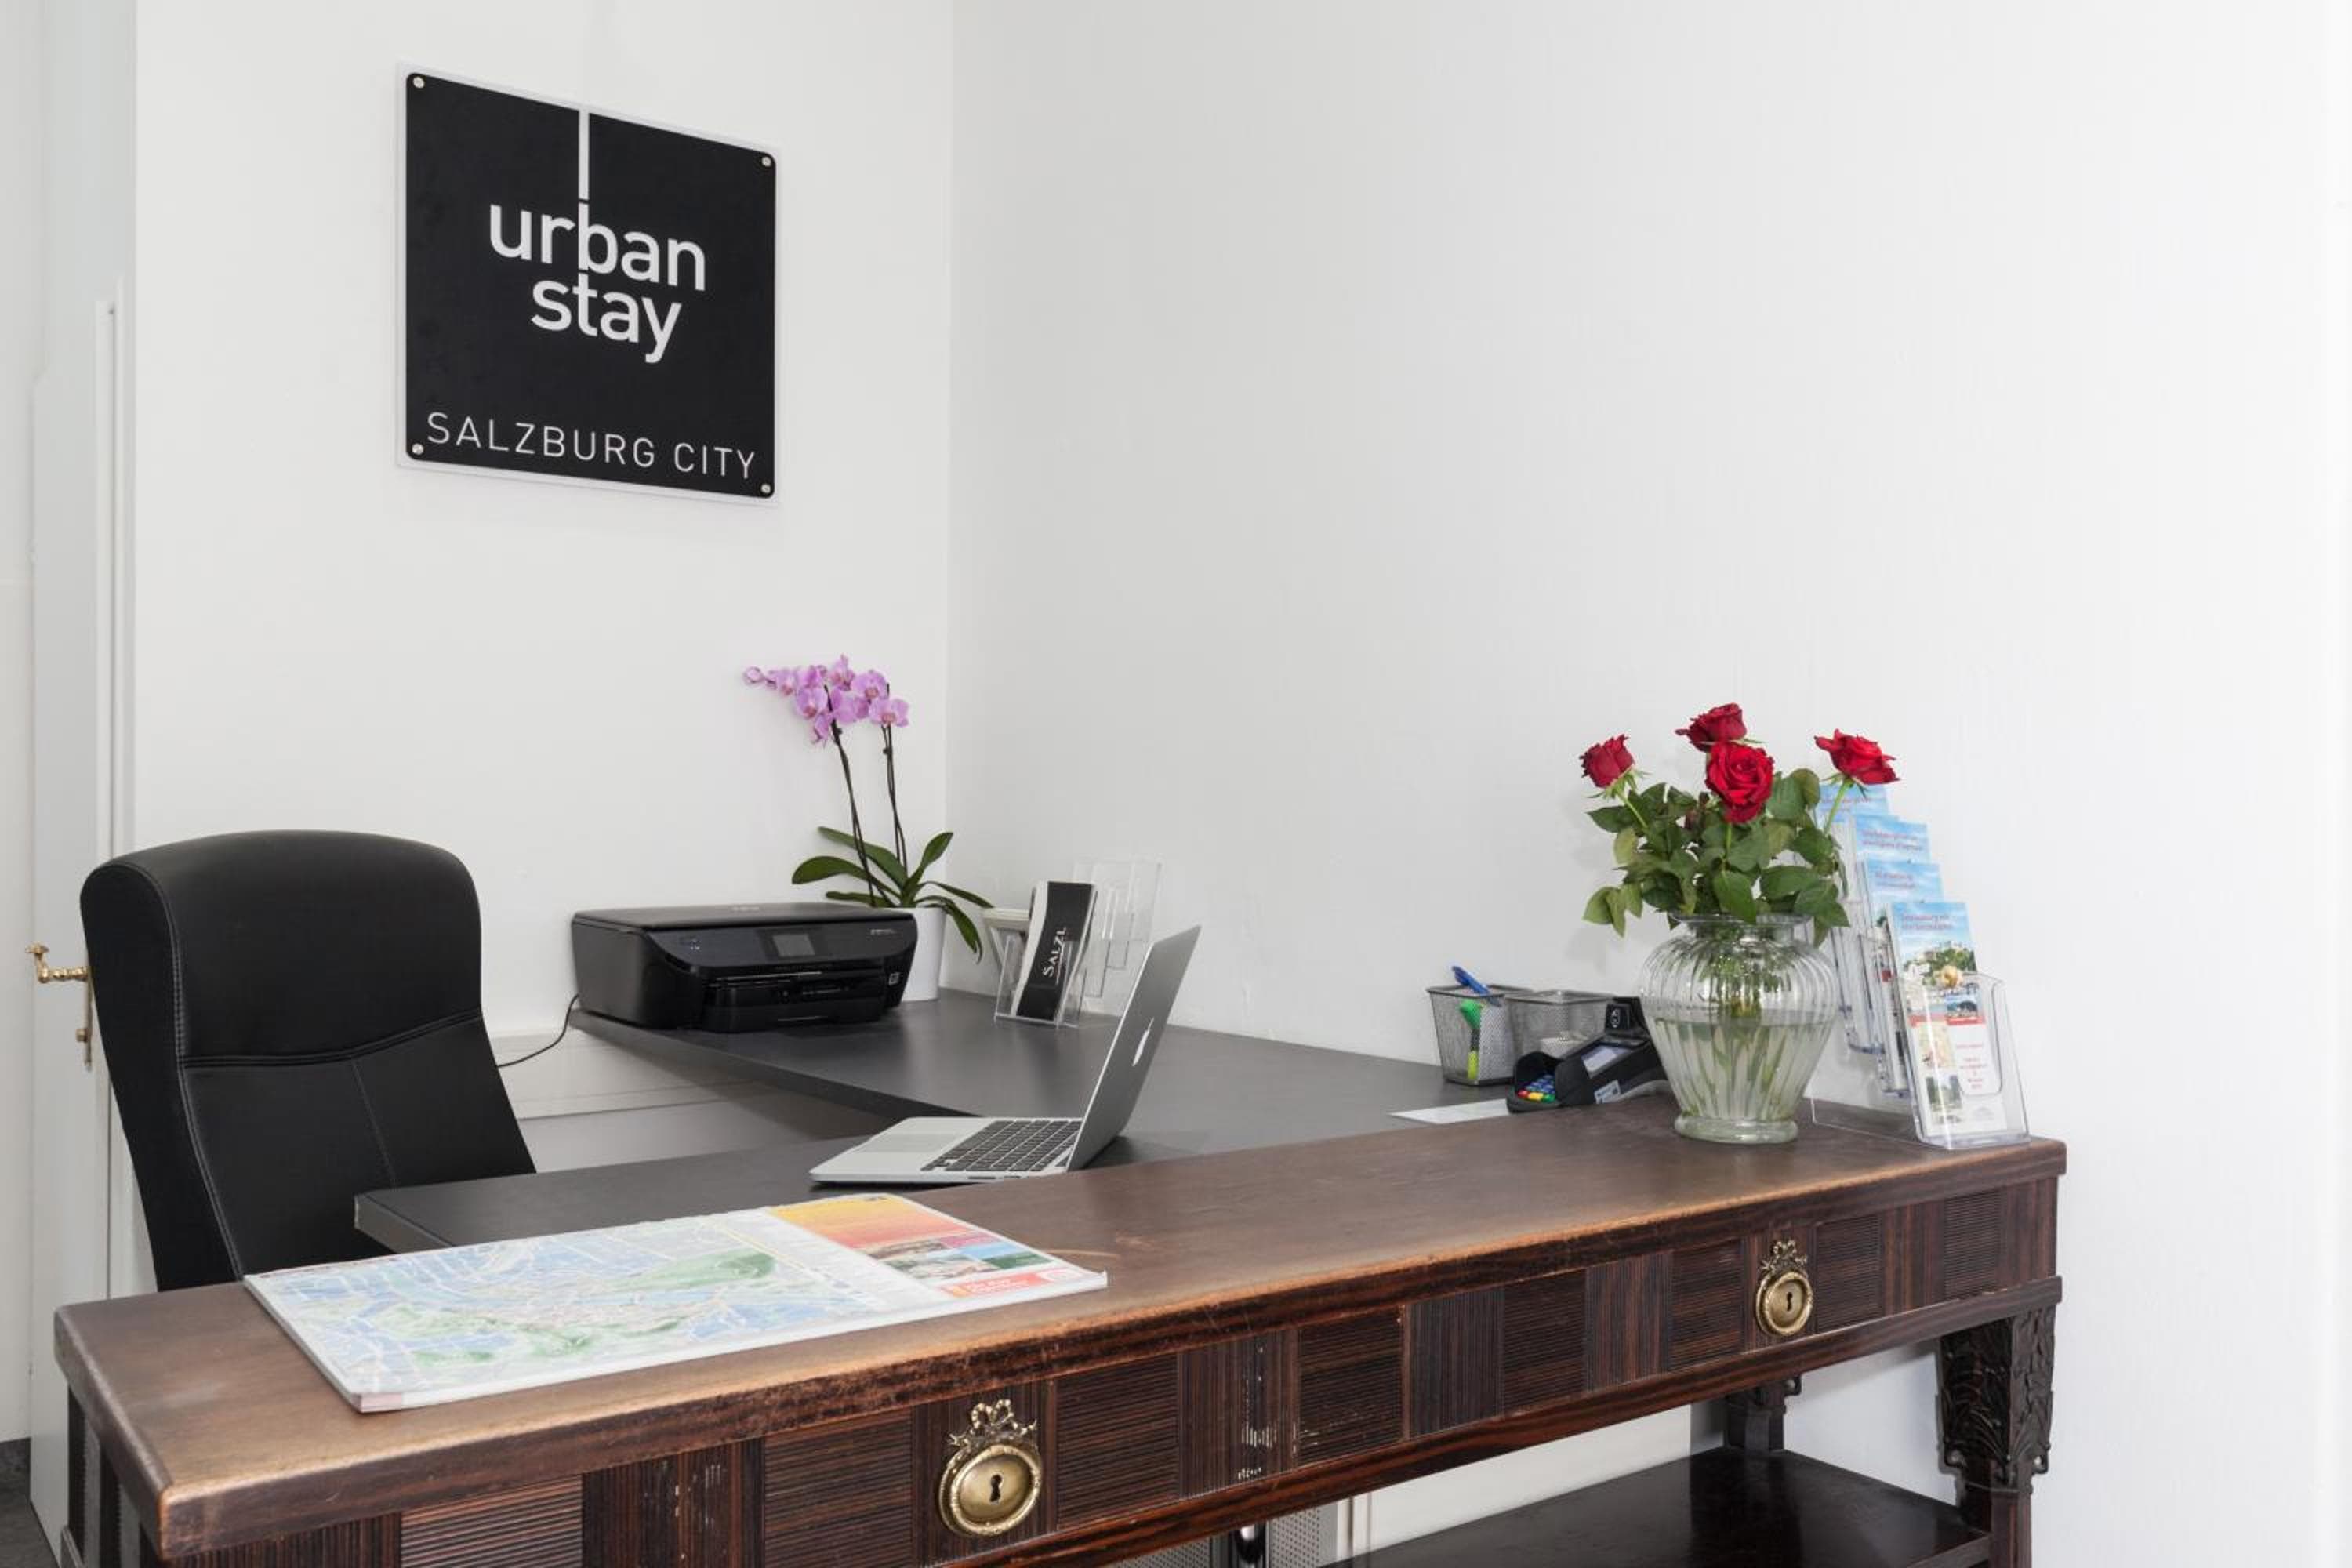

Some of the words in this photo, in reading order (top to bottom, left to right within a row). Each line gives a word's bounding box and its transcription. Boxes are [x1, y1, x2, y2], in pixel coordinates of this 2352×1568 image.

[490, 203, 706, 291] urban
[531, 272, 682, 363] stay
[426, 412, 655, 468] SALZBURG
[673, 442, 755, 479] CITY
